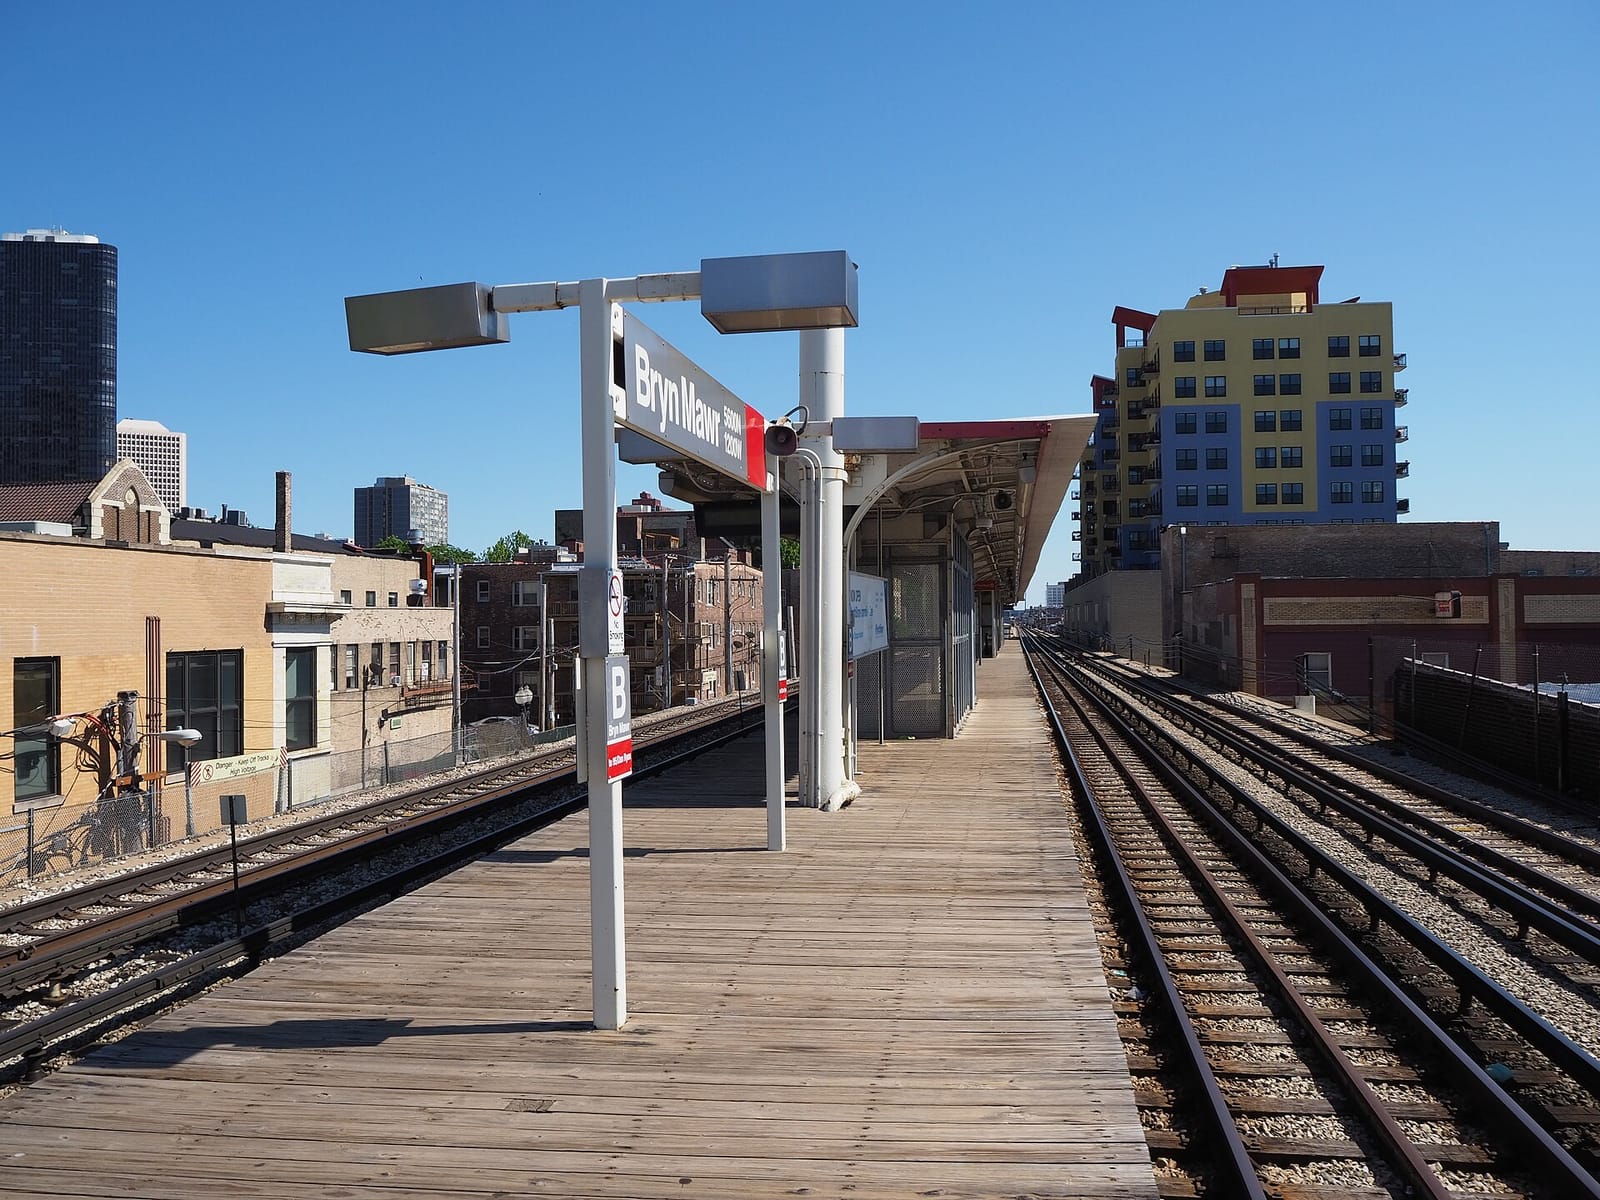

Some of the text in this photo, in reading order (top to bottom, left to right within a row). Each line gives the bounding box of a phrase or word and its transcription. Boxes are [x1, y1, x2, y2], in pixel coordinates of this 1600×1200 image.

[635, 343, 721, 447] Bryn Mawr
[723, 405, 742, 436] 5600N
[723, 432, 743, 461] 1200W
[612, 666, 627, 720] B
[608, 721, 630, 739] Bryn Mawr
[215, 760, 234, 770] Danger
[238, 758, 249, 766] Keep
[241, 765, 257, 774] Voltage
